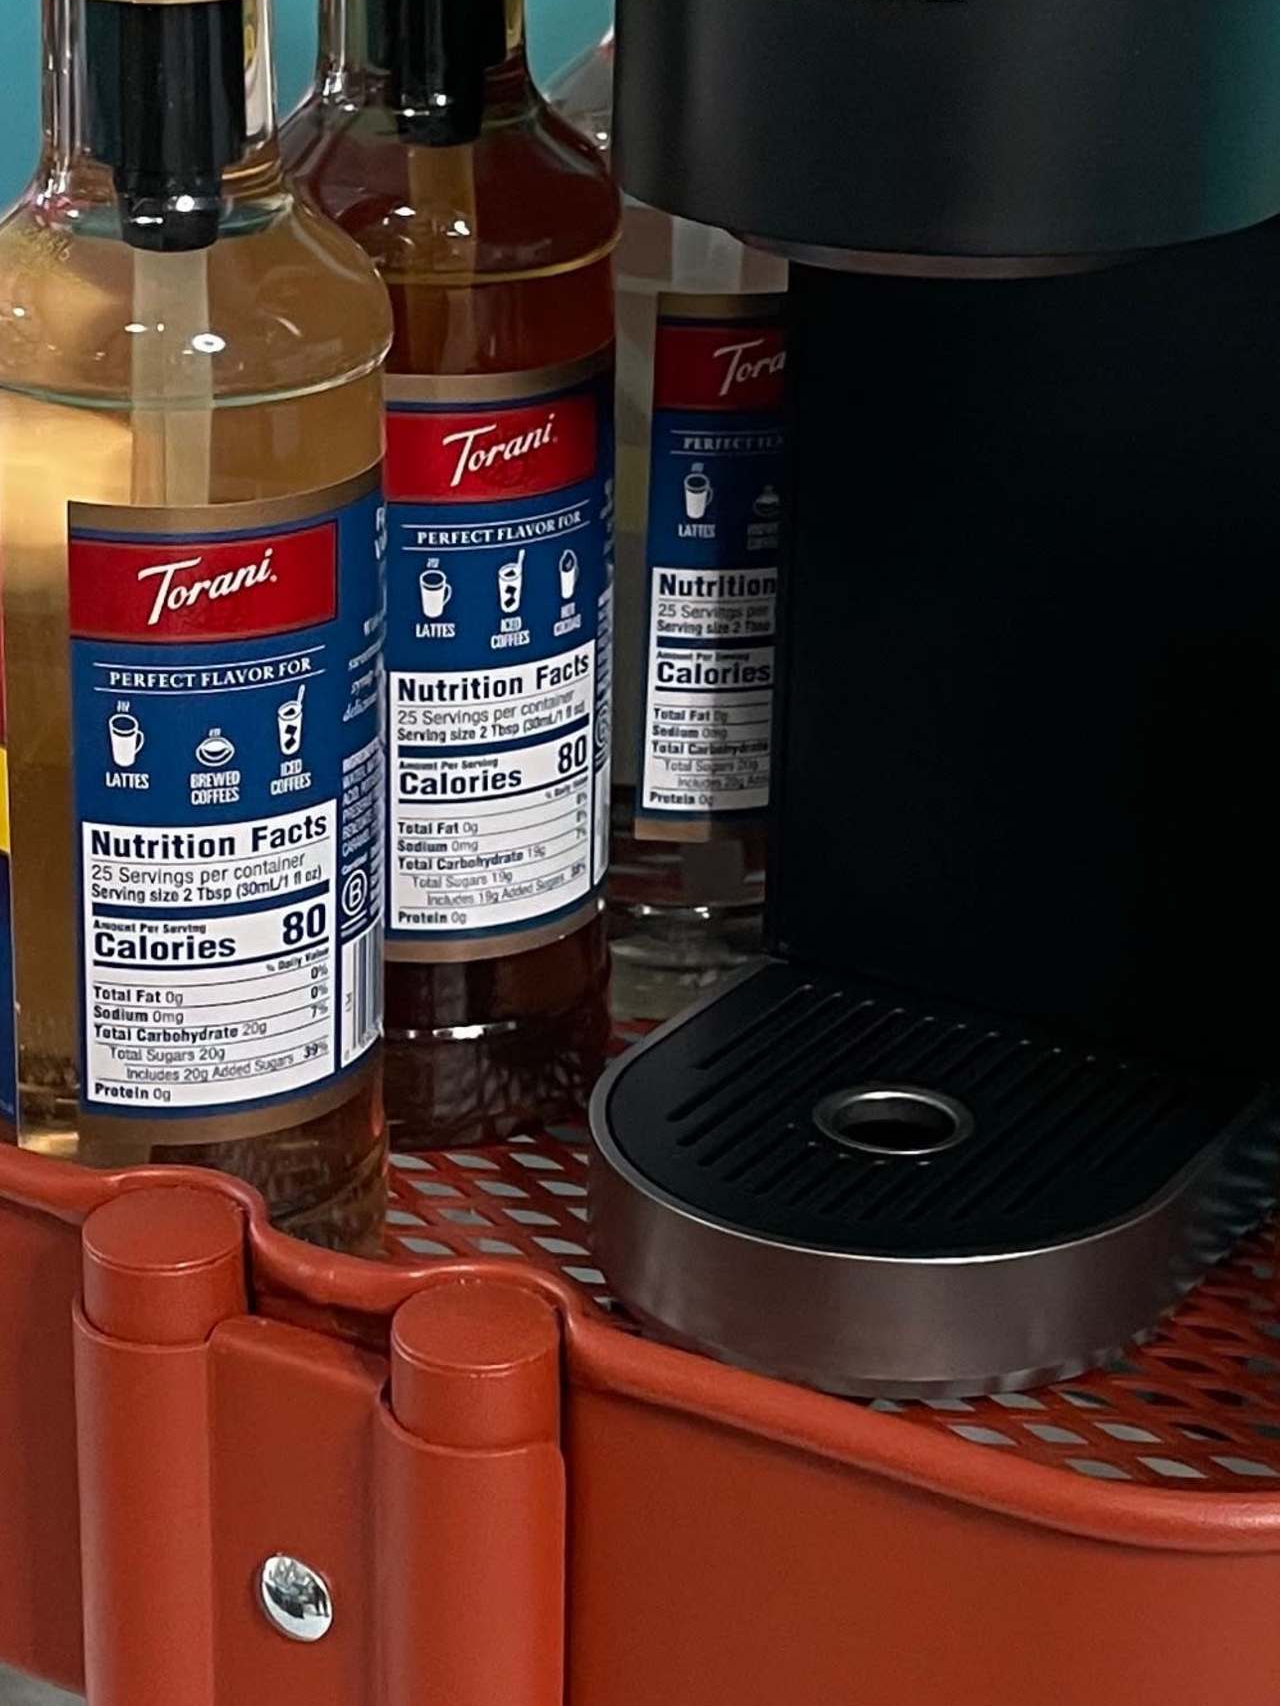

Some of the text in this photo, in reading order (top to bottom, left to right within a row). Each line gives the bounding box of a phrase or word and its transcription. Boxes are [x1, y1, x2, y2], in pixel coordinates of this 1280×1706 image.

[713, 339, 787, 397] Tora
[442, 413, 556, 487] Torani
[417, 529, 493, 545] PERFECT
[497, 521, 556, 542] FLAVOR
[137, 548, 274, 626] Torani
[659, 573, 777, 598] Nutrition
[658, 604, 676, 618] 25
[415, 623, 456, 638] LATTES
[109, 656, 312, 688] PERFECT FLAVOR FOR
[398, 654, 589, 702] Nutrition Facts
[657, 660, 770, 685] Calories
[398, 710, 417, 725] 25
[422, 709, 489, 726] Servings
[493, 707, 516, 723] per
[397, 727, 446, 743] Serving
[450, 728, 476, 740] size
[479, 726, 488, 739] 2
[491, 723, 520, 738] Tbsp
[558, 735, 587, 774] 80
[105, 771, 150, 790] LATTES
[190, 770, 241, 789] BREWED
[399, 770, 522, 795] Calories
[191, 787, 240, 805] COFFEES
[91, 815, 327, 860] Nutrition Facts
[398, 822, 479, 835] Total Fat 0g
[397, 840, 479, 853] Sodium 0mg
[398, 857, 433, 870] Total
[436, 850, 524, 870] Carbohydrate
[92, 853, 306, 888] 25 Servings per container
[92, 884, 146, 903] Serving
[149, 887, 179, 902] size
[183, 887, 193, 902] 2
[198, 884, 232, 901] Tbsp
[236, 874, 290, 901] (30mL/1
[293, 870, 302, 885] fl
[412, 876, 442, 889] Total
[446, 876, 488, 890] Sugars
[93, 919, 207, 935] Amount Per Serving
[282, 902, 326, 946] 80
[398, 912, 467, 925] Protein 0g
[94, 933, 237, 961] Calories
[310, 966, 329, 980] 0%
[93, 986, 184, 1007] Total Fat 0g
[310, 984, 329, 999] 0%
[93, 1006, 184, 1025] Sodium 0mg
[93, 1022, 267, 1044] Total Carbohydrate 20g
[110, 1048, 225, 1063] Total Sugars 20g
[126, 1054, 294, 1082] Includes 20g Added Sugars
[94, 1083, 171, 1102] Protein 0g
